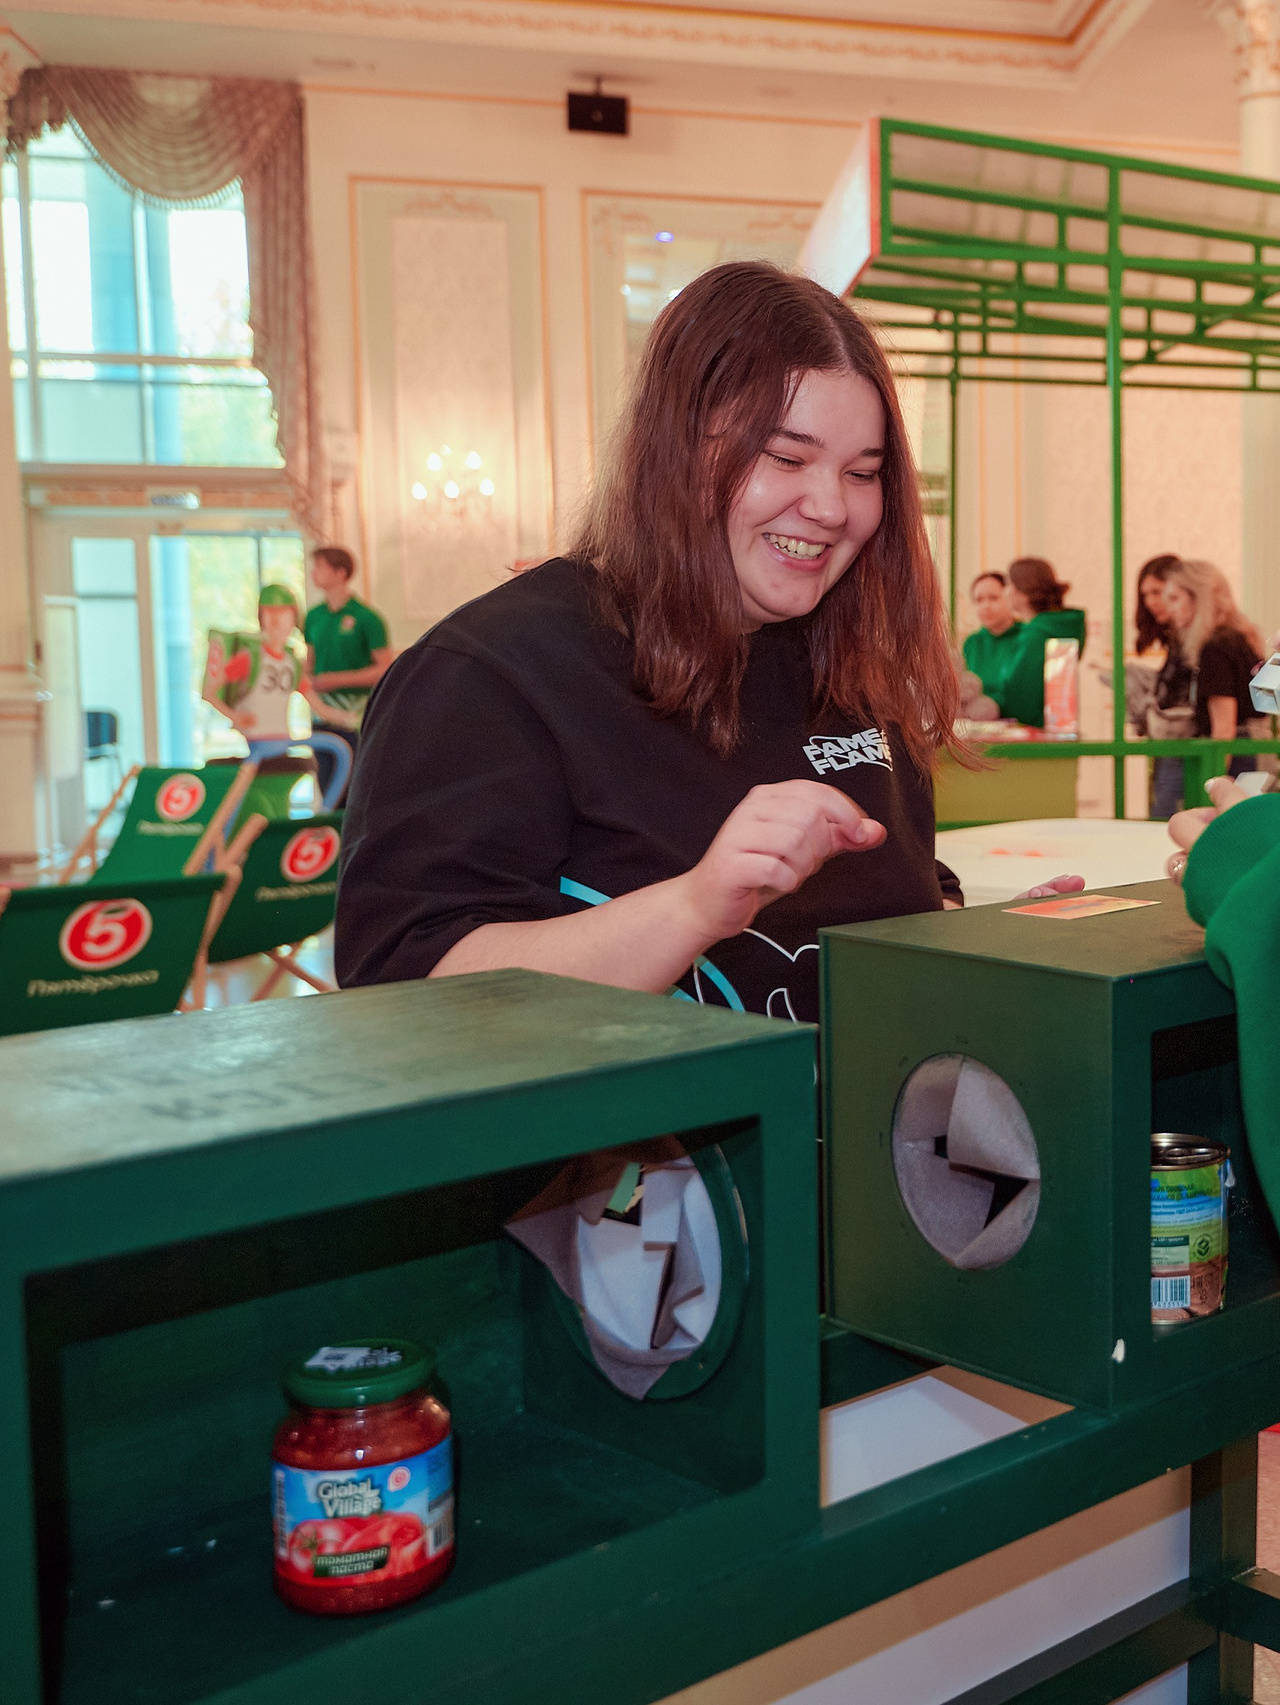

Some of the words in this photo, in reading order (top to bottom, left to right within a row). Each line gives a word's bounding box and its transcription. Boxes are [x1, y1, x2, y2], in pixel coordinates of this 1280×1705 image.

[802, 727, 883, 762] FAME
[811, 743, 892, 775] FLAM
[318, 1478, 380, 1499] Global
[322, 1496, 382, 1518] Village
